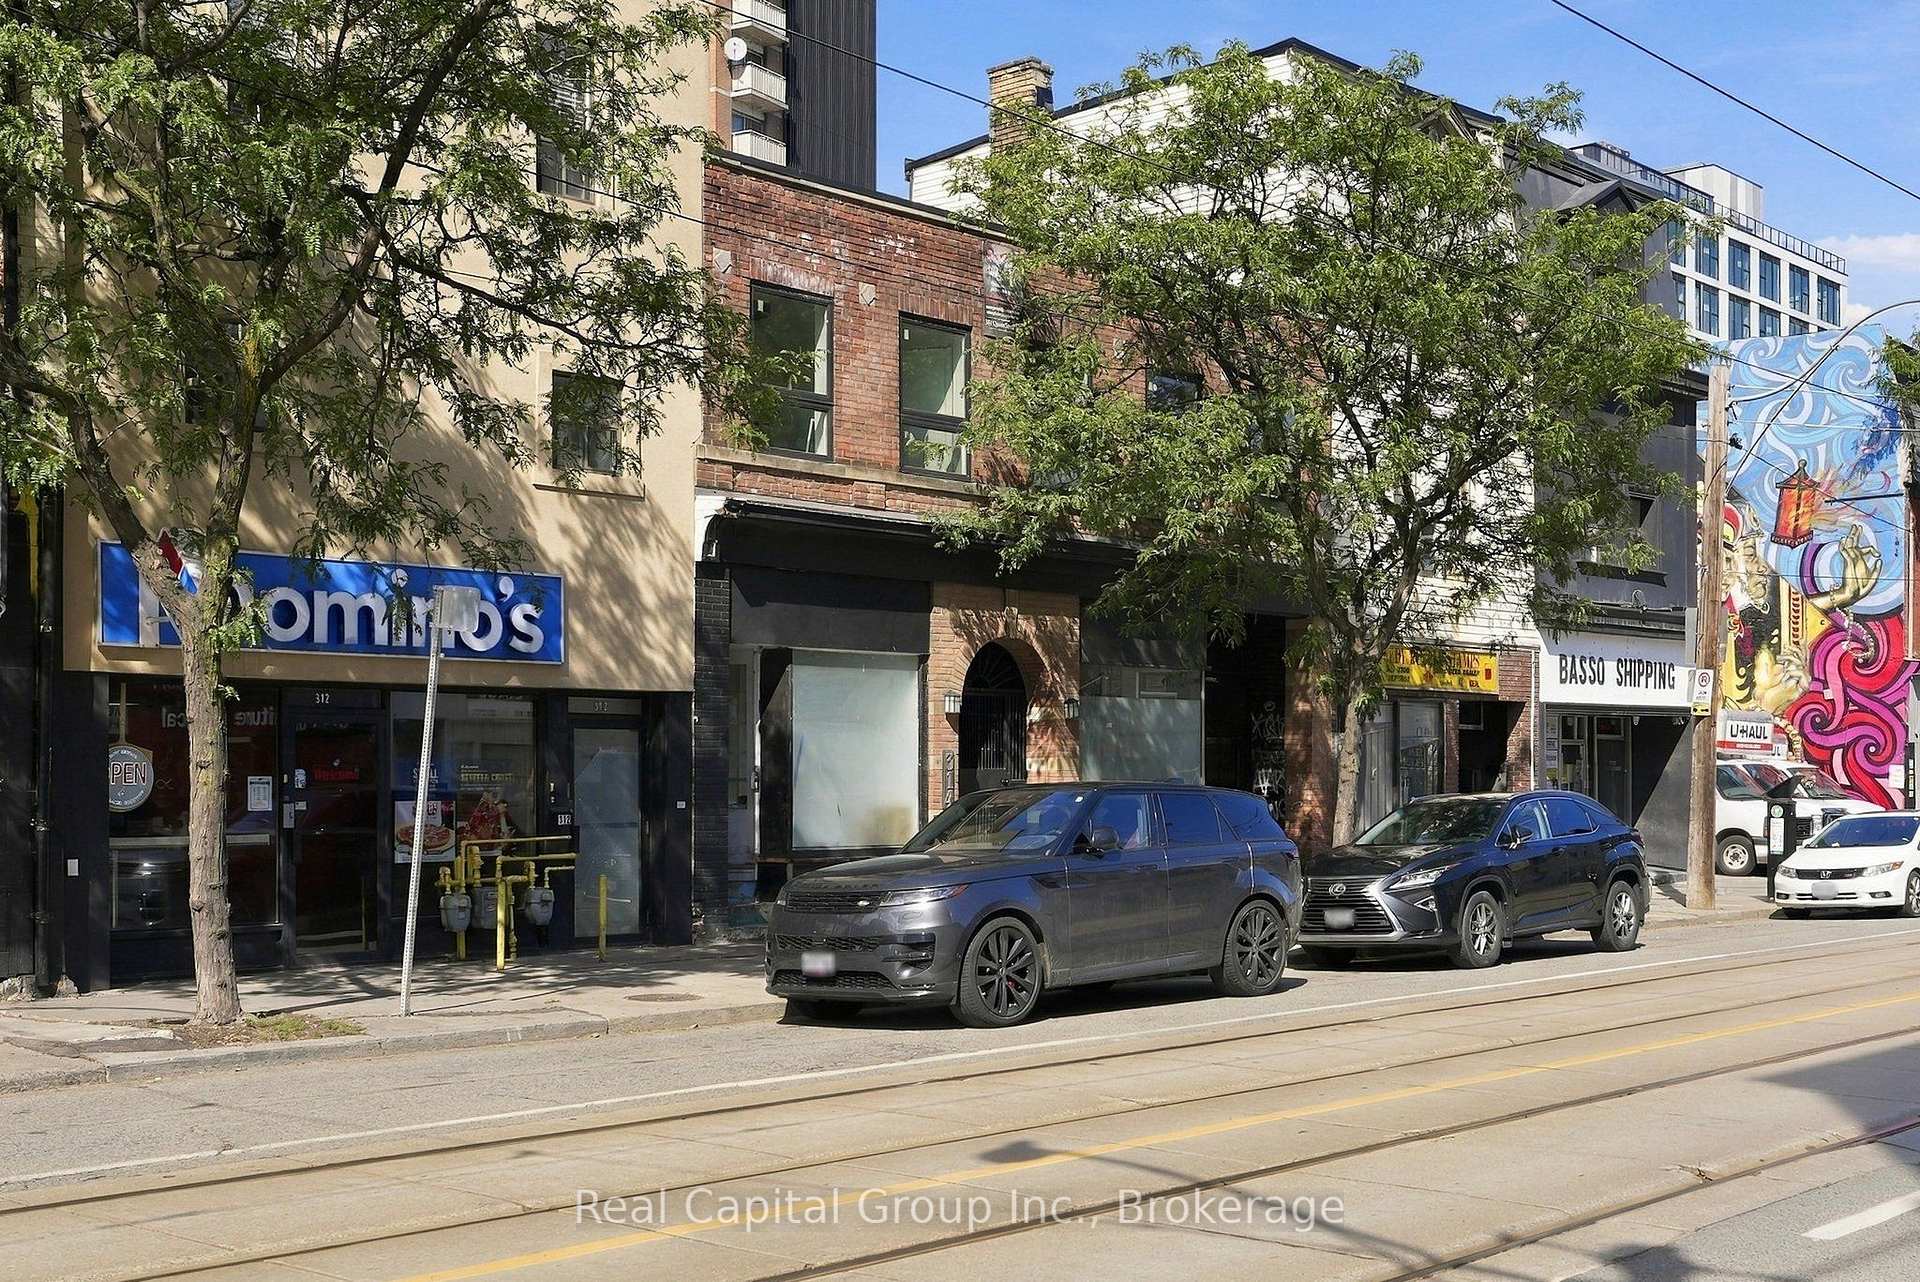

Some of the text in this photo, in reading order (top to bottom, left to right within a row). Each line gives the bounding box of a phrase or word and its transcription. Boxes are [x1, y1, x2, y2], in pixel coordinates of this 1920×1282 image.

[226, 567, 546, 654] omino's
[1559, 653, 1676, 690] BASSO SHIPPING
[314, 692, 330, 704] 312
[109, 761, 147, 786] PEN
